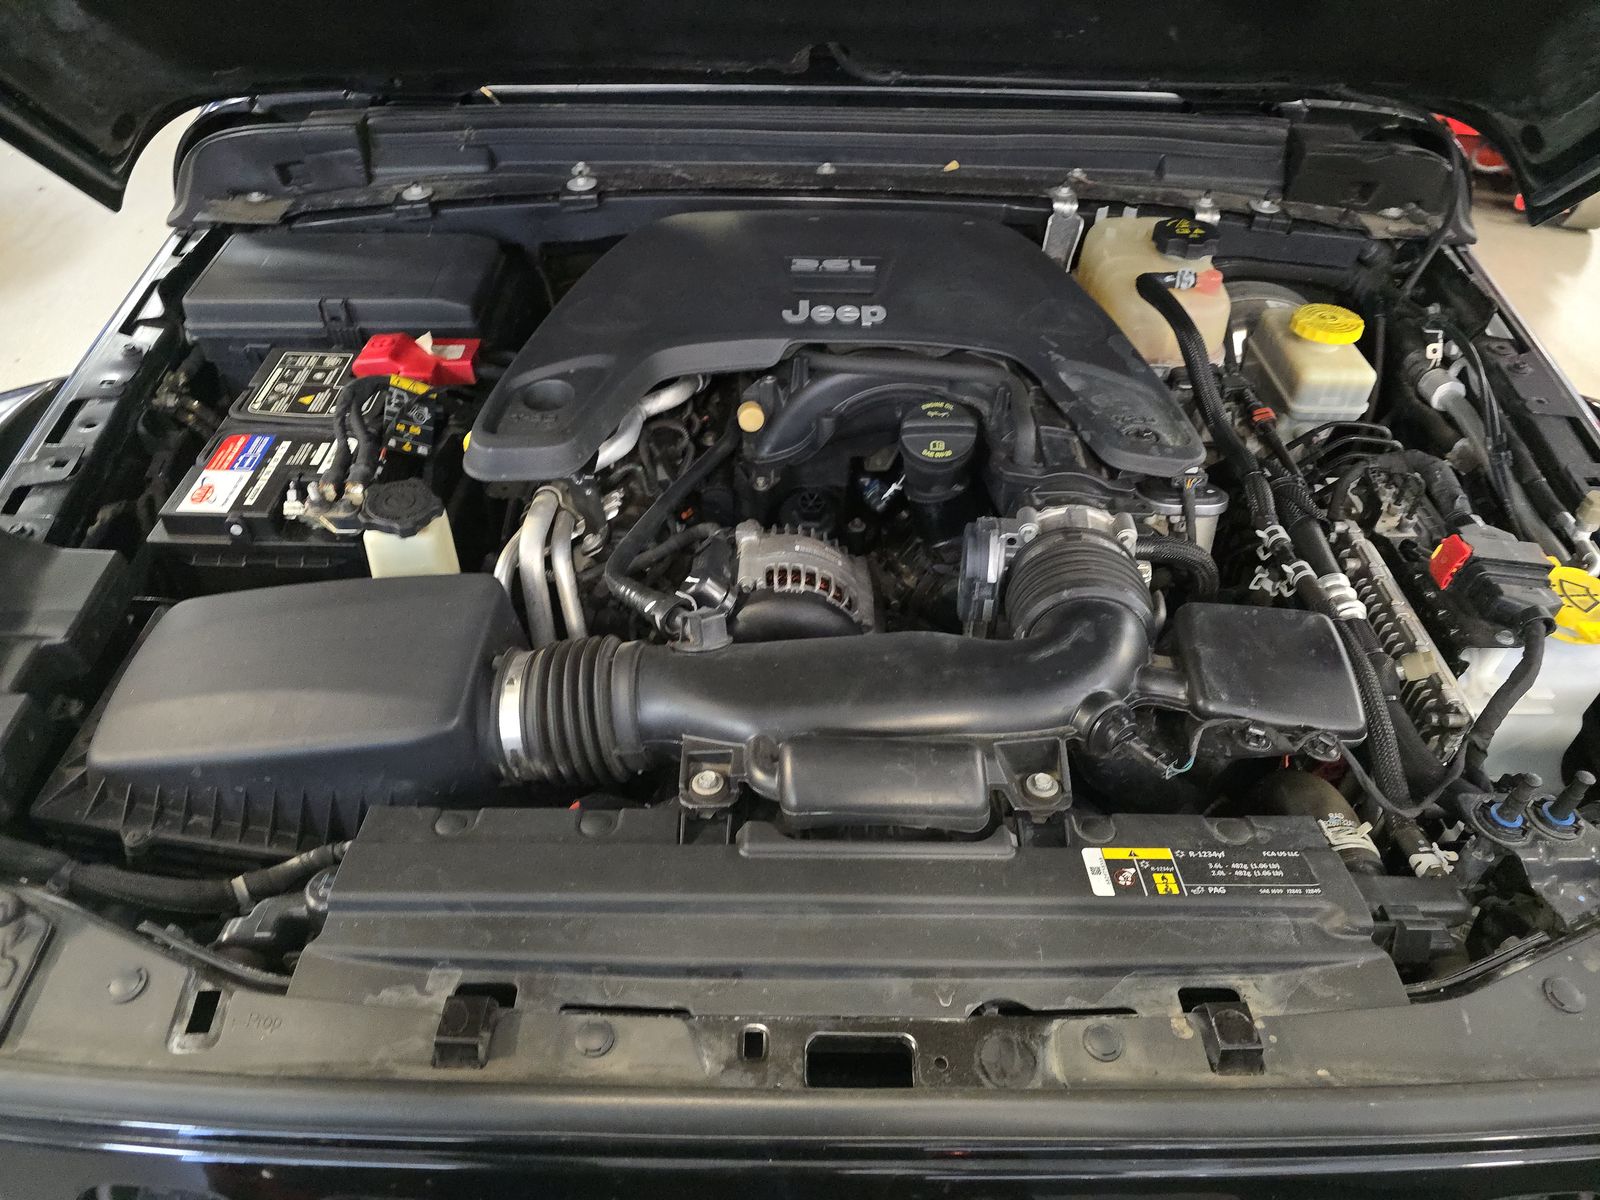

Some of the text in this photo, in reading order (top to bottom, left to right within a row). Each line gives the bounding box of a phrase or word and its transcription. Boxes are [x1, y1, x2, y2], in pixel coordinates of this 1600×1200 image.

[781, 299, 887, 327] Jeep
[1188, 850, 1225, 859] R-1234yf
[1207, 886, 1226, 894] PAG
